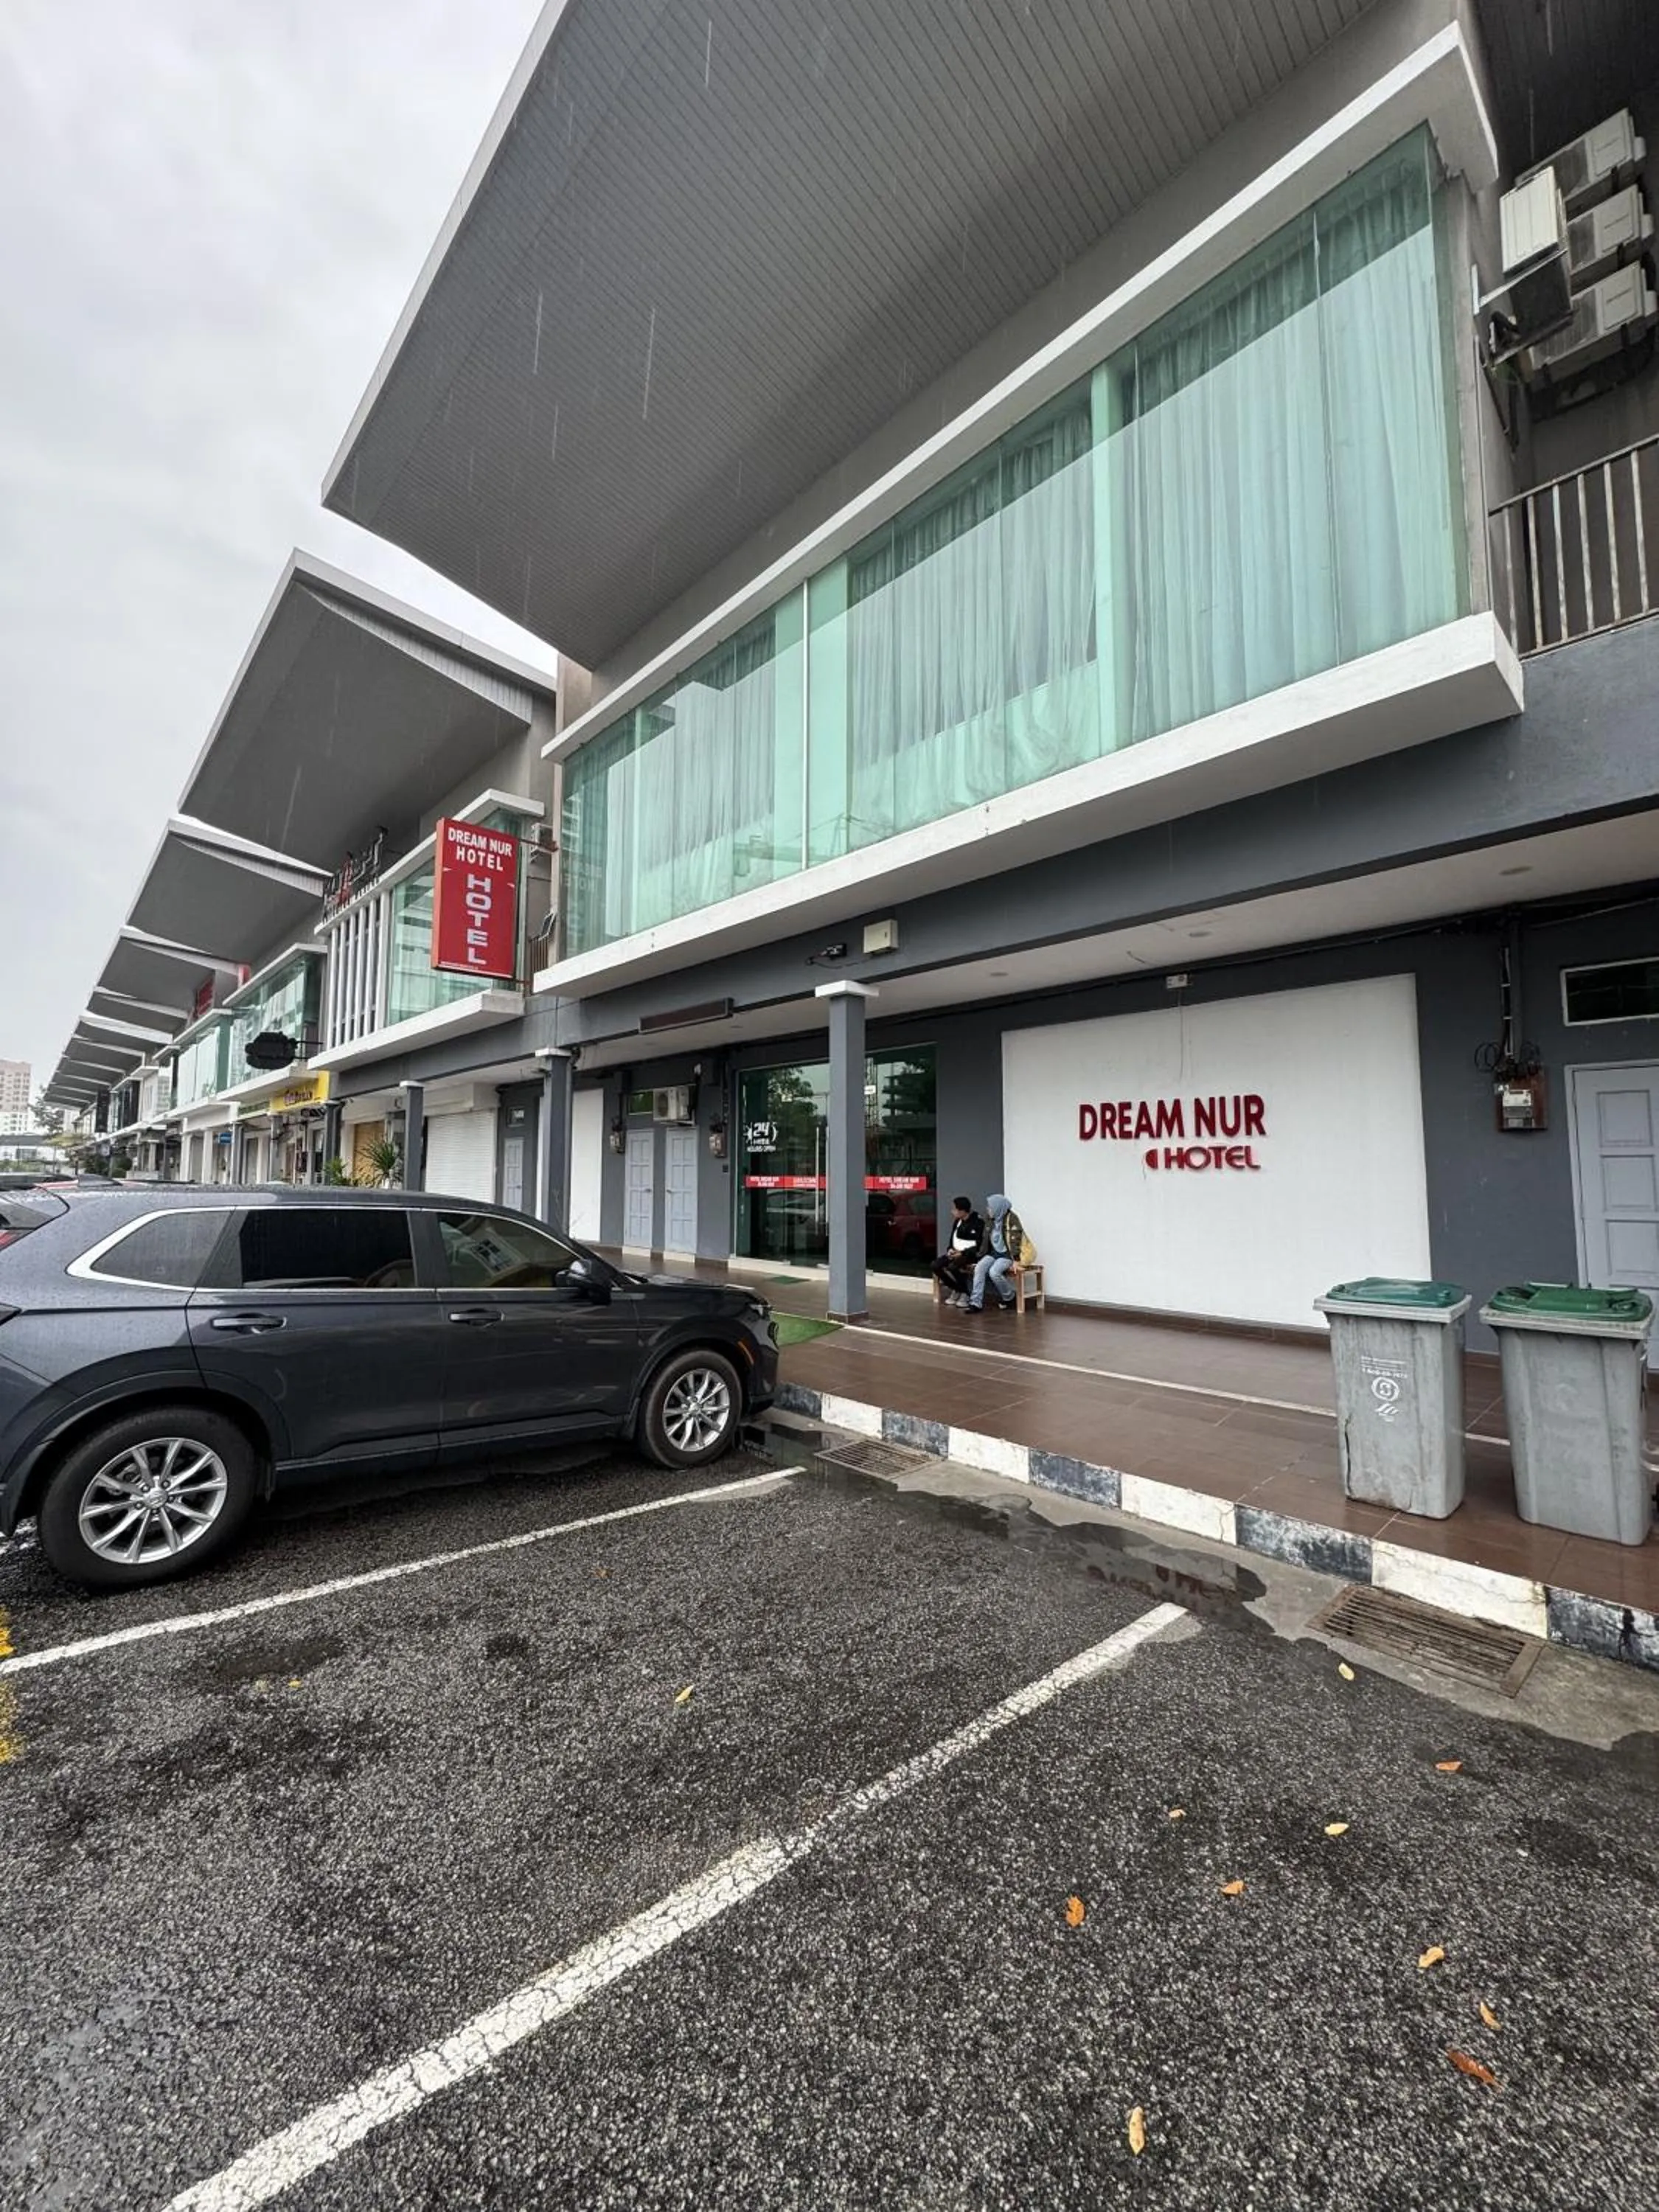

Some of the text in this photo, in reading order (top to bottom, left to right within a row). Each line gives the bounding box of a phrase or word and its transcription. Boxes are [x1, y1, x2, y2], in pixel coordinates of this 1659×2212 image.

[448, 827, 512, 857] DREAM NUR
[456, 846, 504, 871] HOTEL
[465, 874, 492, 964] HOTEL
[1079, 1094, 1266, 1140] DREAM NUR
[1164, 1146, 1261, 1169] HOTEL
